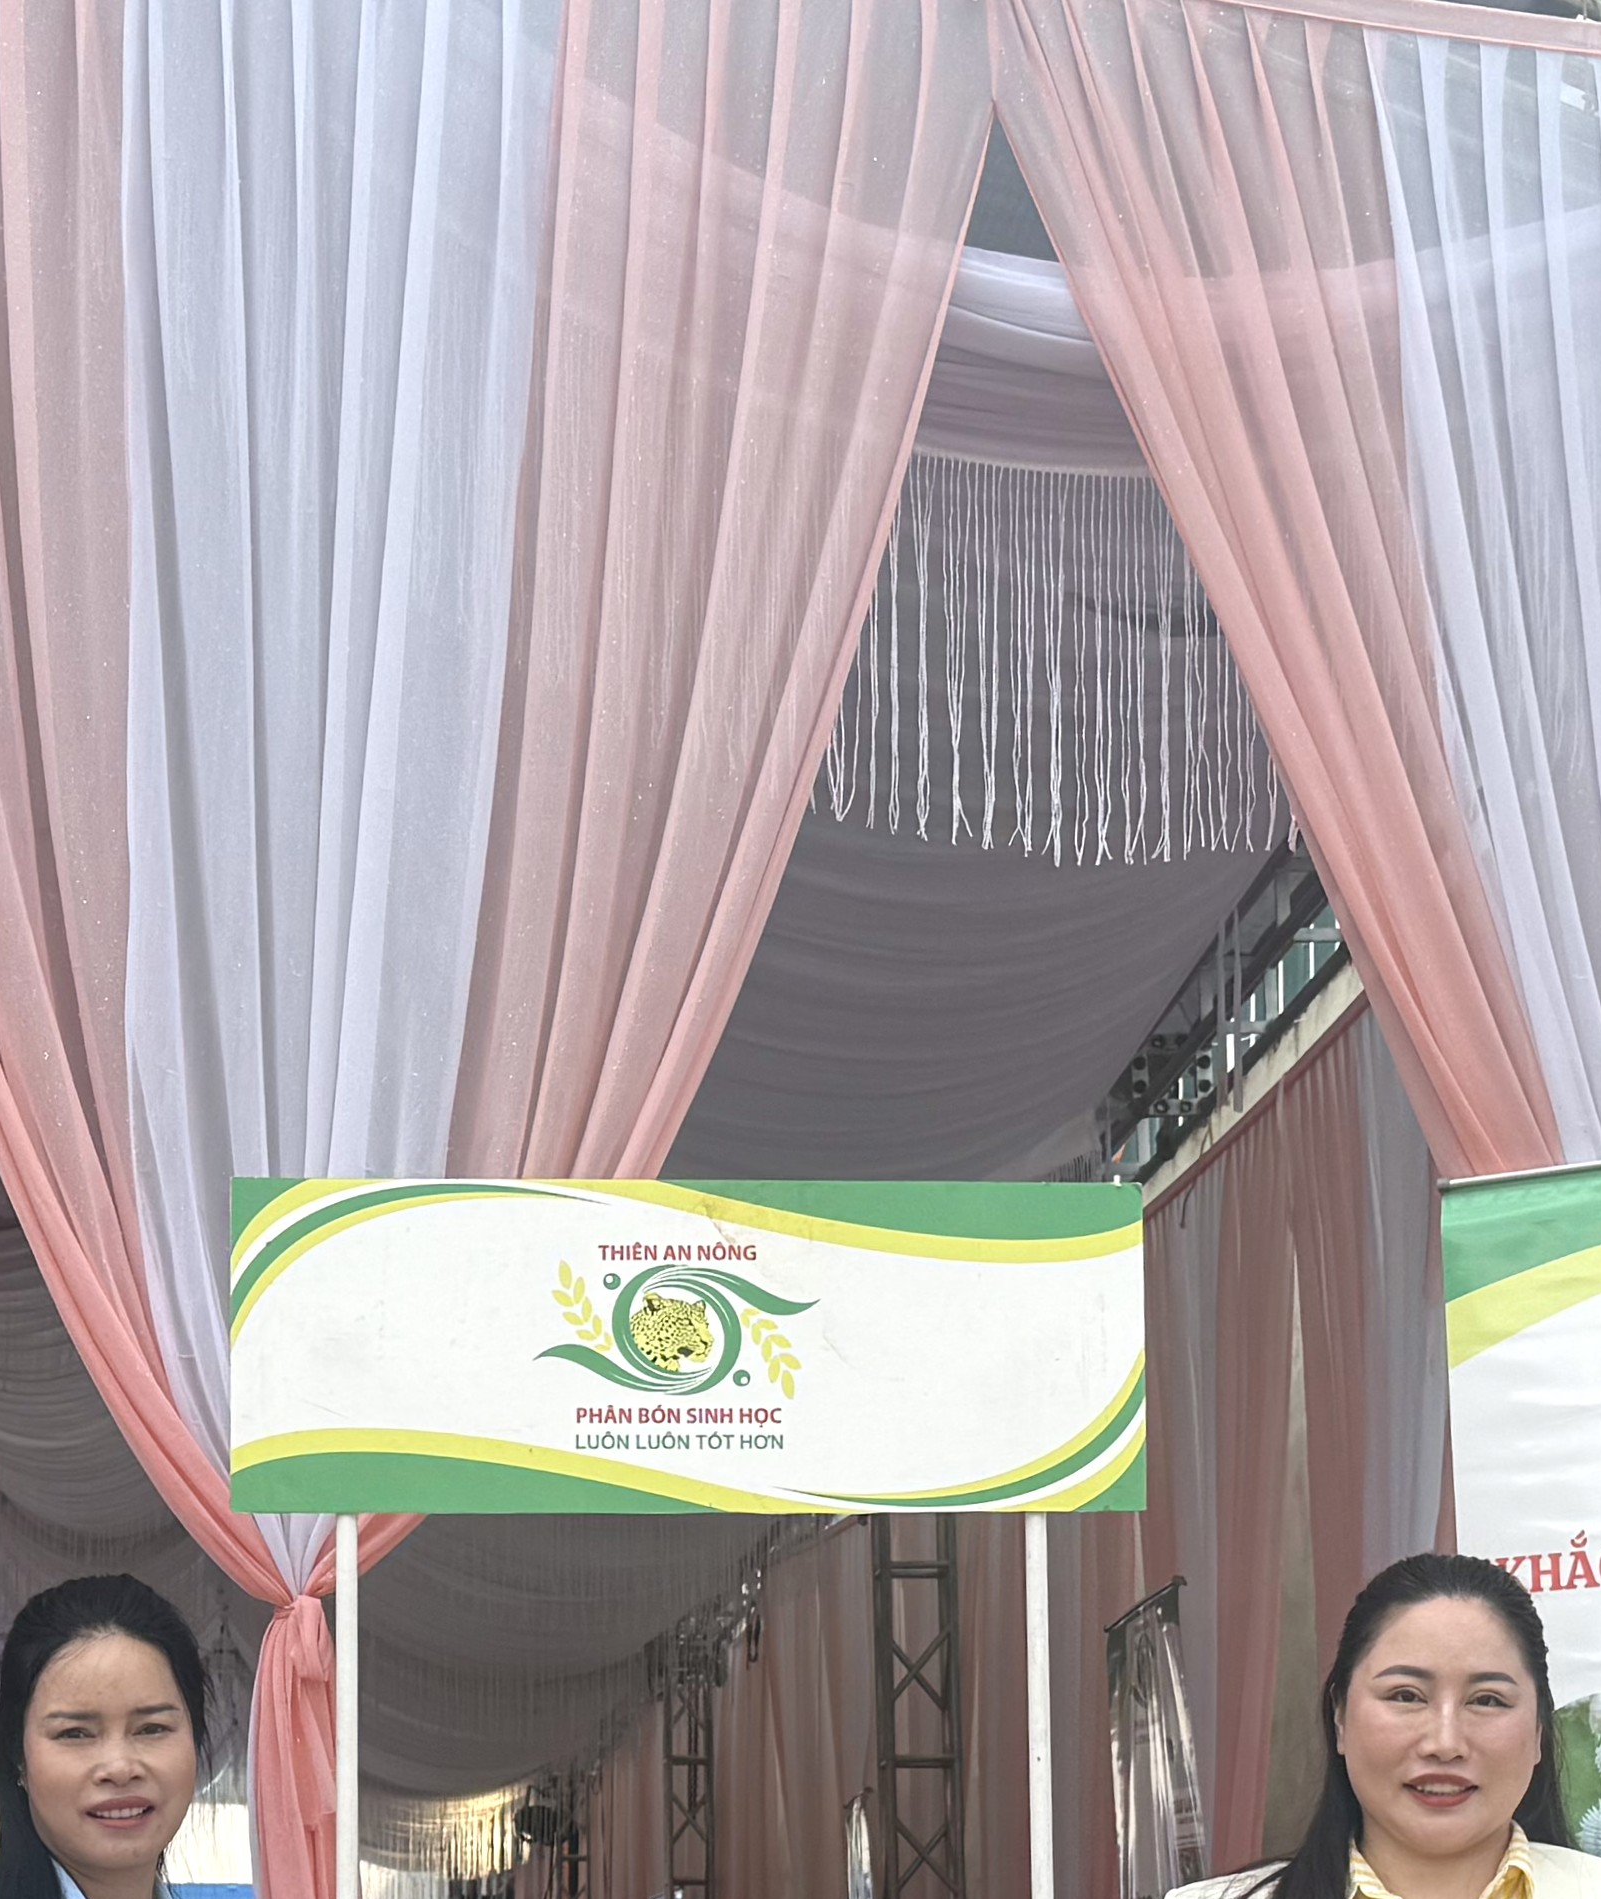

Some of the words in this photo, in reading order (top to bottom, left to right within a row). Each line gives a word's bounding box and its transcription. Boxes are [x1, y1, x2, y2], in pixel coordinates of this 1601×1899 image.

[598, 1242, 657, 1261] THIÊN
[663, 1245, 691, 1261] AN
[697, 1242, 756, 1261] NÔNG
[576, 1405, 631, 1424] PHÂN
[638, 1405, 681, 1424] BÓN
[686, 1408, 732, 1424] SINH
[739, 1408, 781, 1427] HỌC
[576, 1431, 629, 1449] LUÔN
[636, 1431, 690, 1449] LUÔN
[740, 1435, 784, 1449] HƠN
